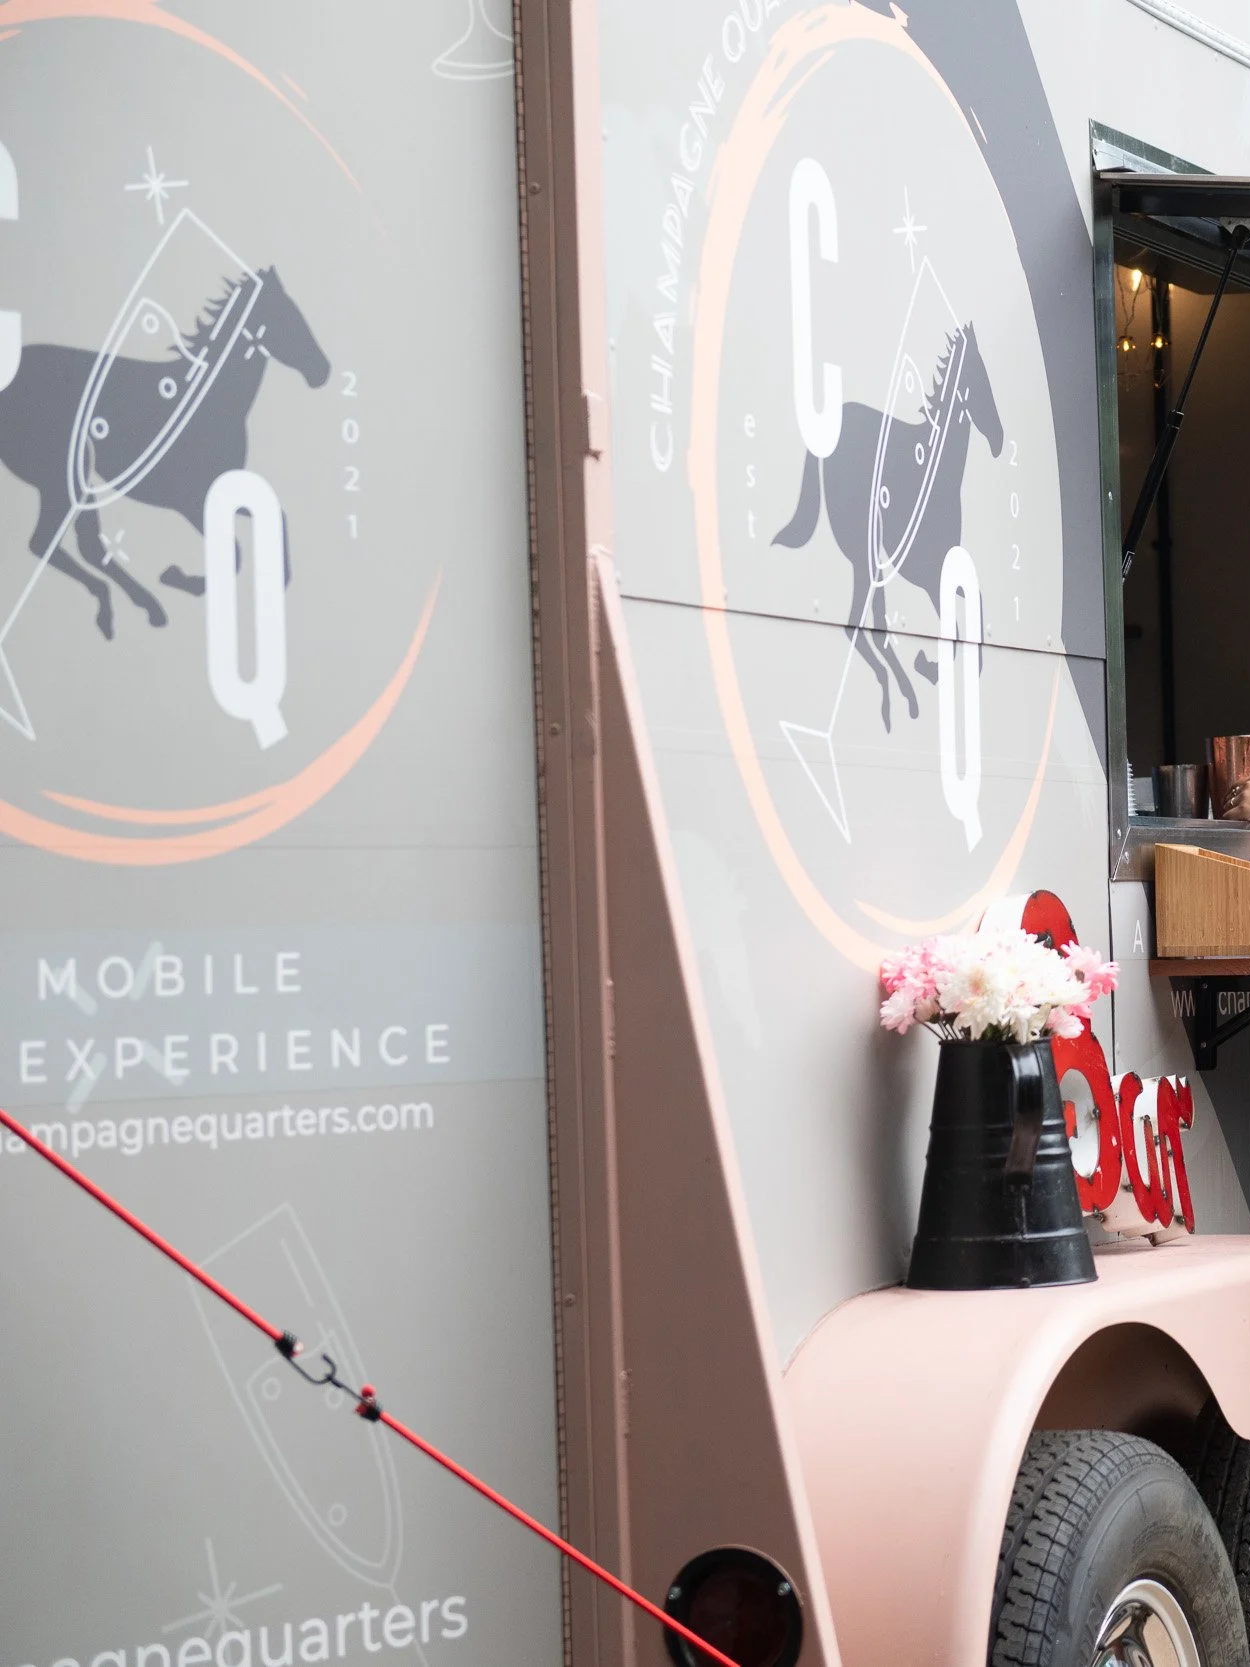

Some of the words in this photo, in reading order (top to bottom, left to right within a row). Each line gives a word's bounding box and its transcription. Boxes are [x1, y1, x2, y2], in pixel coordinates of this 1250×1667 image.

[788, 156, 843, 459] C
[339, 370, 363, 541] 2021
[742, 412, 758, 540] est
[1008, 439, 1023, 622] 2021
[204, 468, 289, 750] Q
[938, 544, 984, 854] Q
[18, 1024, 452, 1085] EXPERIENCE
[37, 951, 303, 1000] MOBILE
[0, 1100, 434, 1158] ampagnequarters.com
